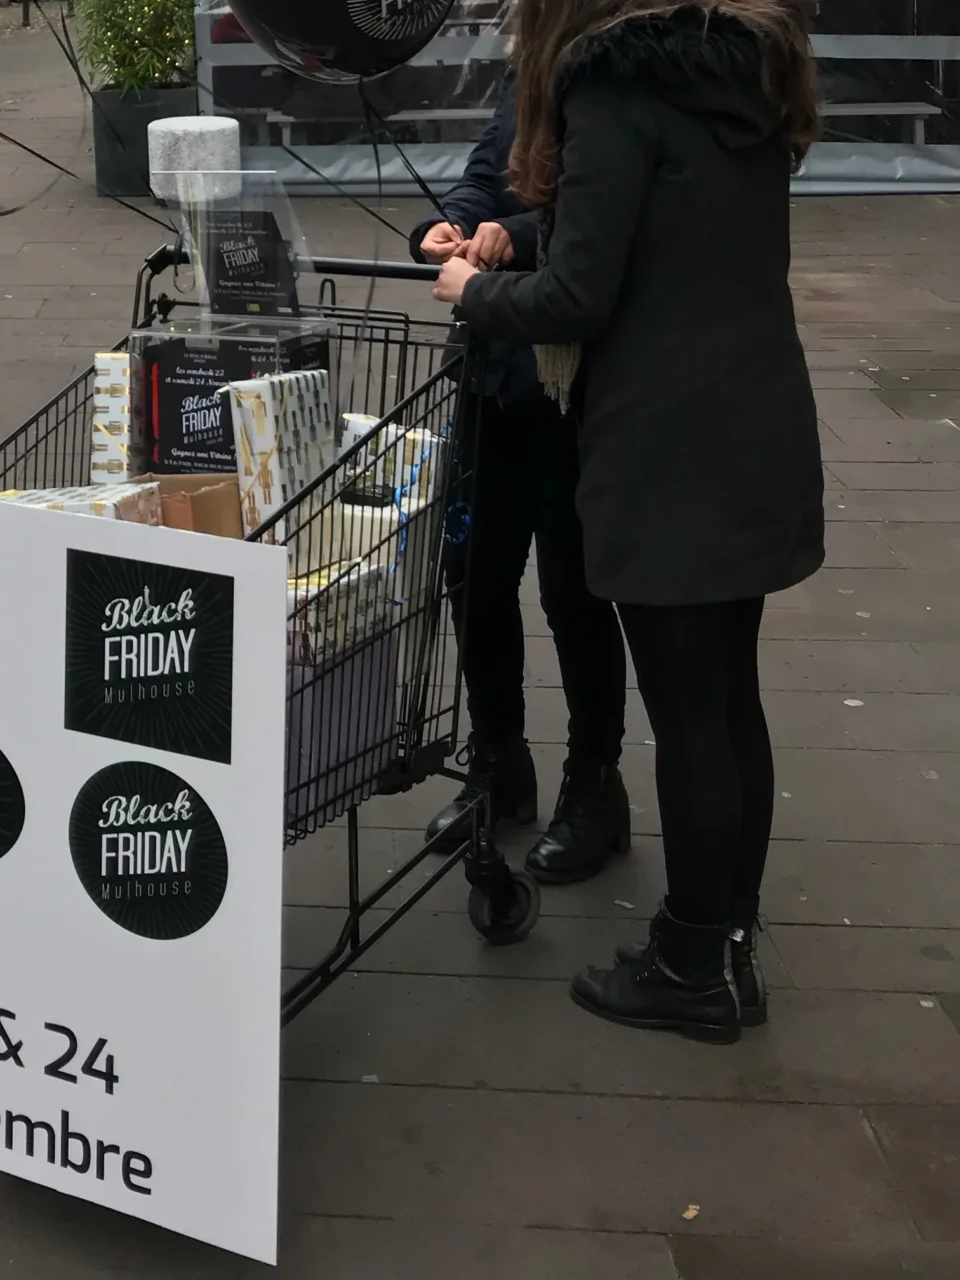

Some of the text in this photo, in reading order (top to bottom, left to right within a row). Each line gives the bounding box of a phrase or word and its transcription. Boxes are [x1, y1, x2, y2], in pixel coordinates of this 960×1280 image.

[220, 235, 256, 252] Black
[222, 247, 260, 268] FRIDAY
[180, 392, 221, 413] Black
[182, 406, 222, 434] FRIDAY
[183, 428, 224, 444] Mulhouse
[101, 586, 196, 632] Black
[104, 628, 196, 680] FRIDAY
[104, 679, 195, 704] Mulhouse
[98, 789, 193, 828] Black
[101, 828, 193, 877] FRIDAY
[101, 879, 193, 900] Mulhouse
[43, 1021, 119, 1096] 24
